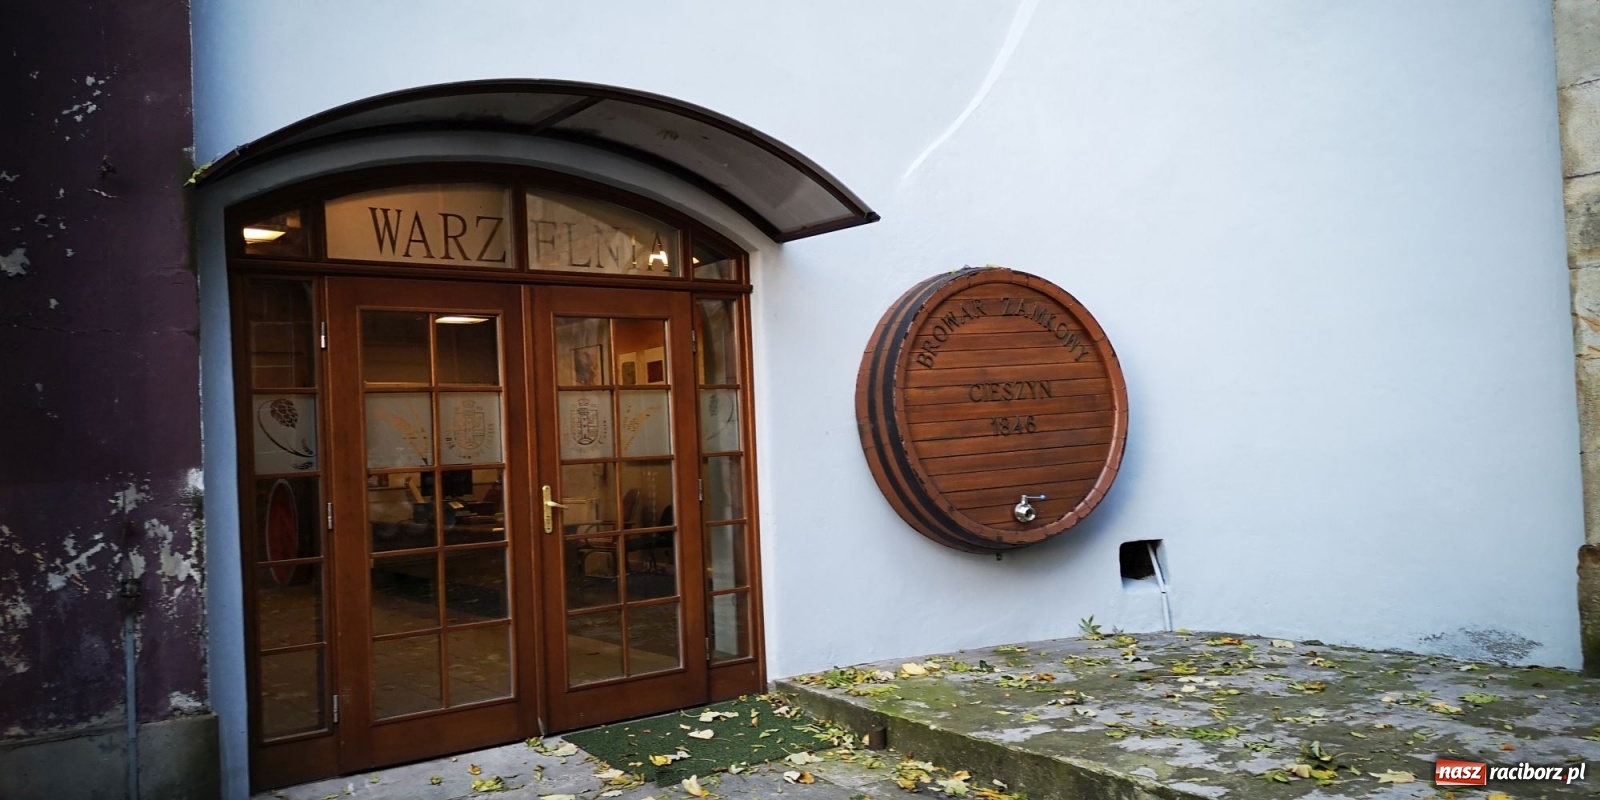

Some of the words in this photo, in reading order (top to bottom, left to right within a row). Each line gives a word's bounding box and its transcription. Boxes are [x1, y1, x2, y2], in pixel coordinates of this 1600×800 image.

[917, 299, 987, 369] BROWAR
[1001, 297, 1089, 362] ZAMKOWY
[968, 379, 1053, 403] CIESZYN
[991, 415, 1037, 436] 1846
